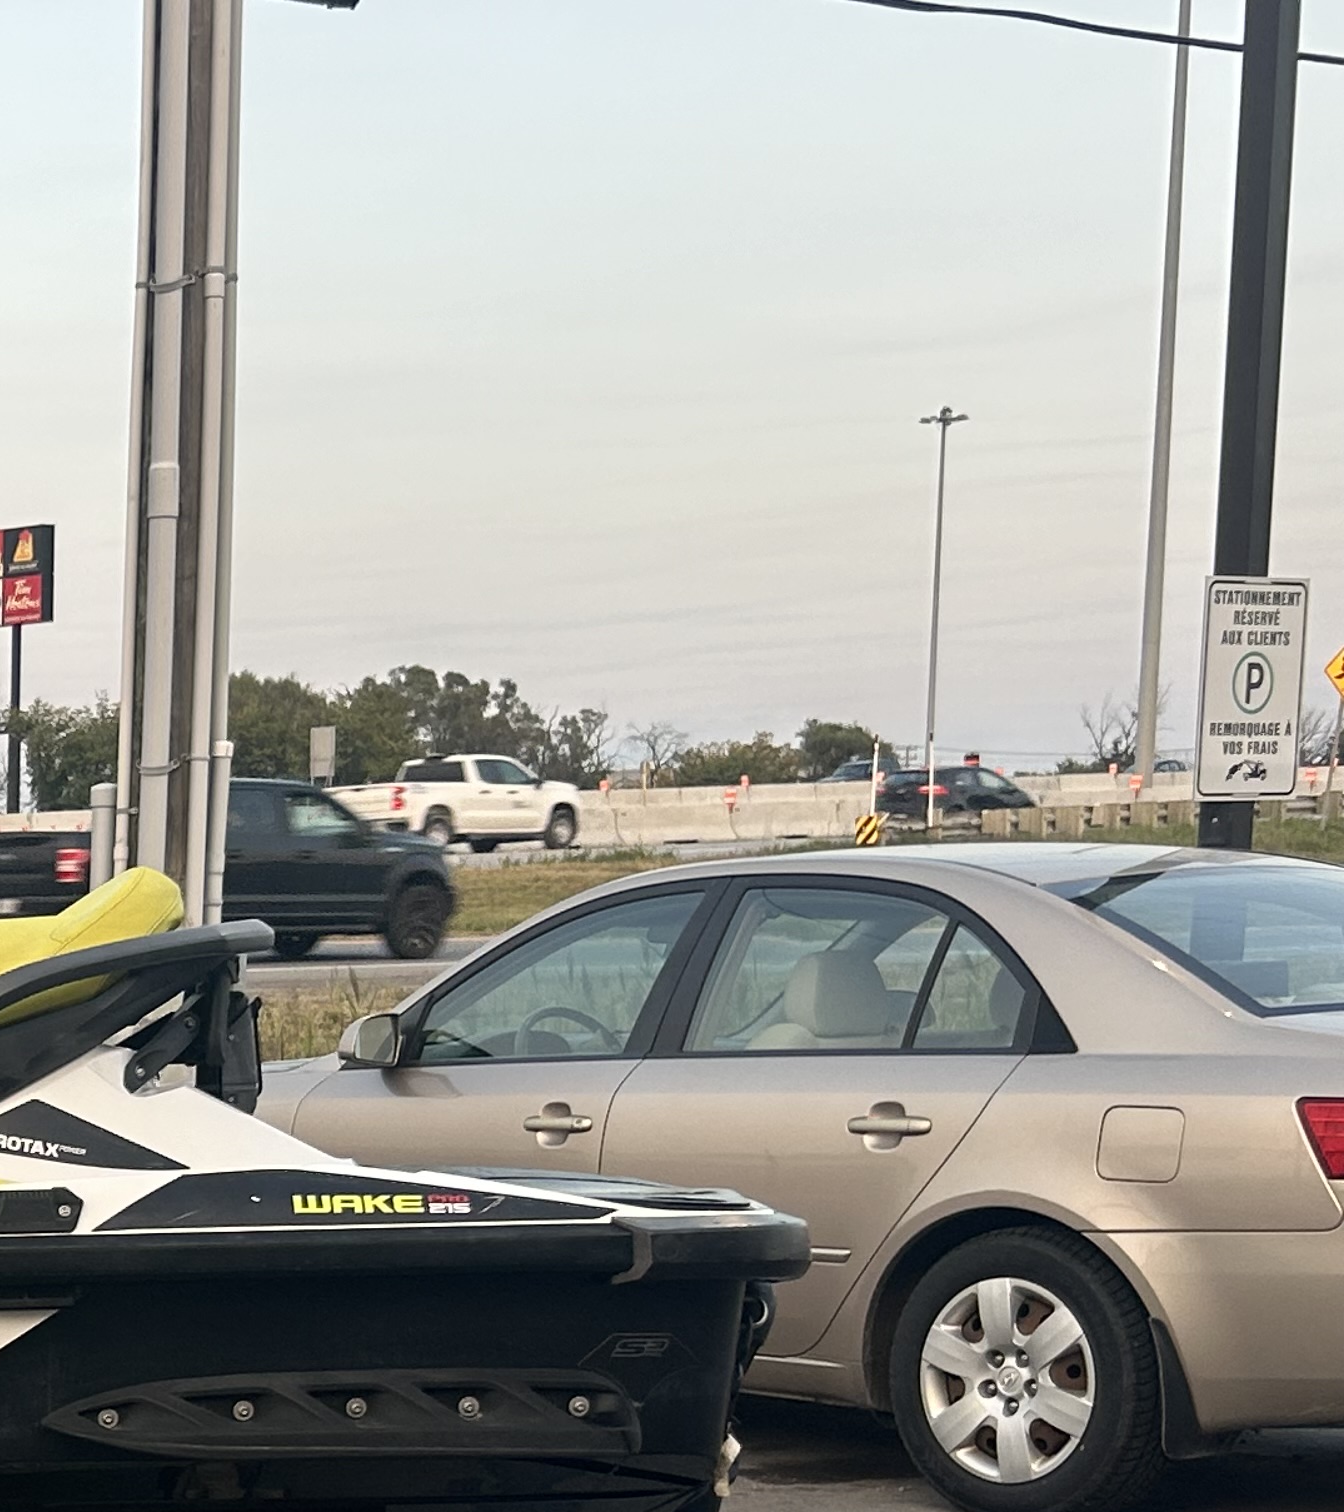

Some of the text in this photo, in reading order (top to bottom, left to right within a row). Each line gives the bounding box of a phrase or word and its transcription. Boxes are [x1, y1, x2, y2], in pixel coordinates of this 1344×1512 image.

[1214, 590, 1302, 606] STATIONNEMENT
[1233, 609, 1281, 625] RÉSERVÉ
[1221, 630, 1291, 646] AUX CLIENTS
[1244, 662, 1265, 705] P
[1209, 719, 1292, 739] REMORQUAGE À
[1223, 741, 1279, 756] VOS FRAIS
[291, 1194, 426, 1215] WAKE
[428, 1203, 471, 1214] 215
